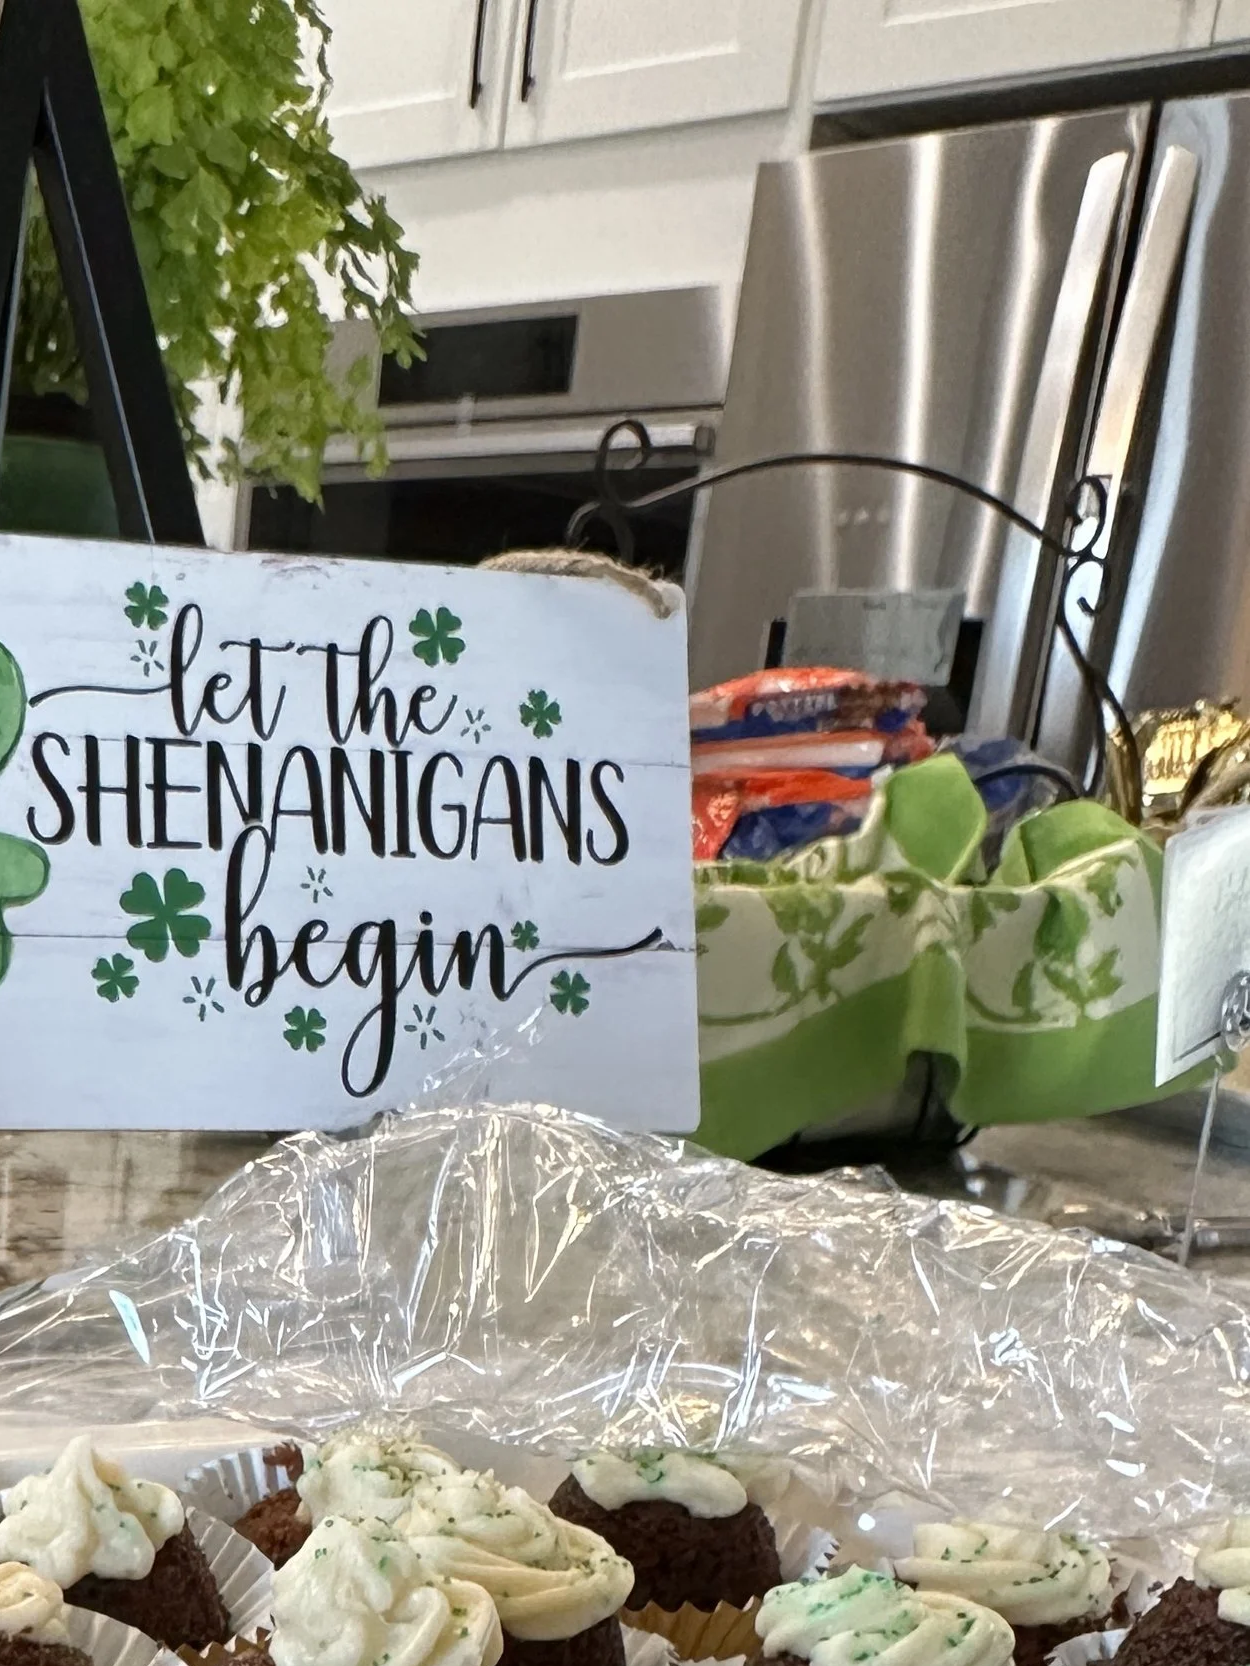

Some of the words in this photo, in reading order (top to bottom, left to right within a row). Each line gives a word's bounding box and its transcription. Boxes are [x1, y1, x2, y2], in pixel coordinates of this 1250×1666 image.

[297, 615, 458, 745] the
[27, 732, 630, 866] SHENANIGANS
[225, 824, 663, 1098] begin
